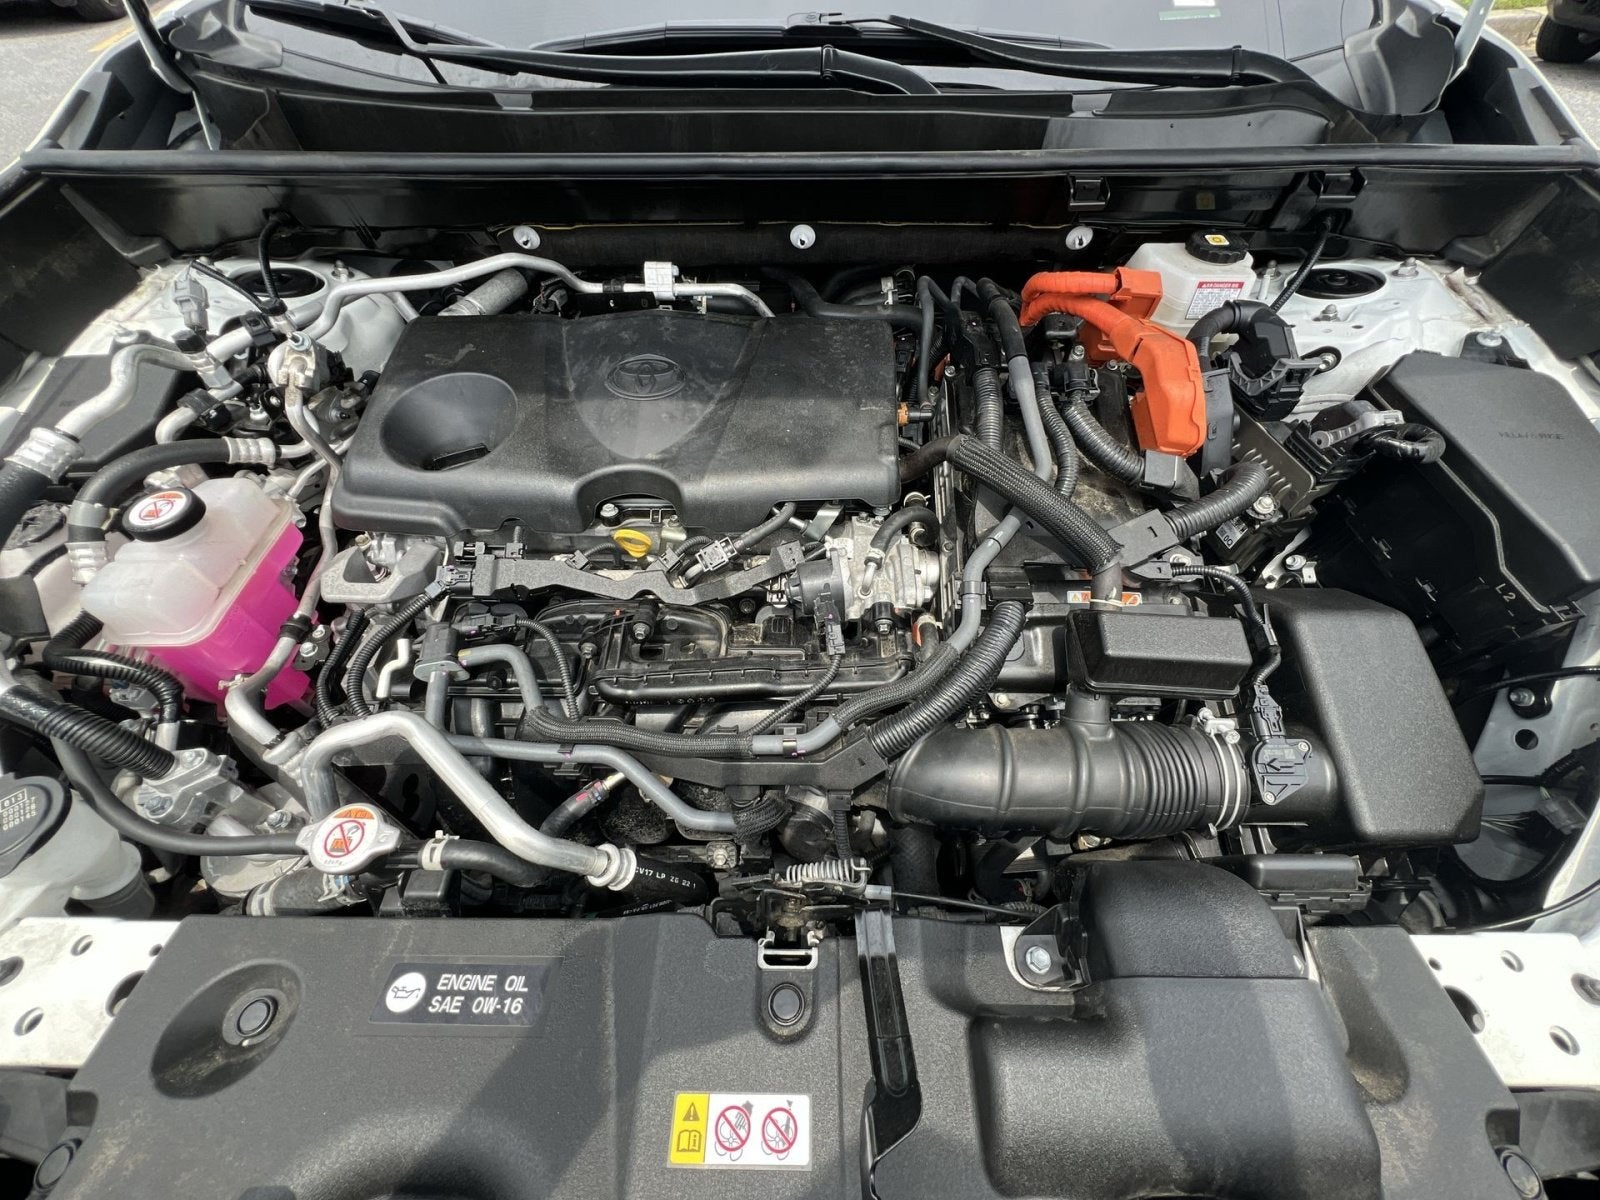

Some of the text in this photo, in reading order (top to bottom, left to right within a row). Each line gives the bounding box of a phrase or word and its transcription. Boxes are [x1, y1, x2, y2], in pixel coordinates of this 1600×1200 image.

[1496, 583, 1515, 602] L2
[437, 974, 529, 992] ENGINE OIL
[428, 996, 523, 1015] SAE 0W-16
